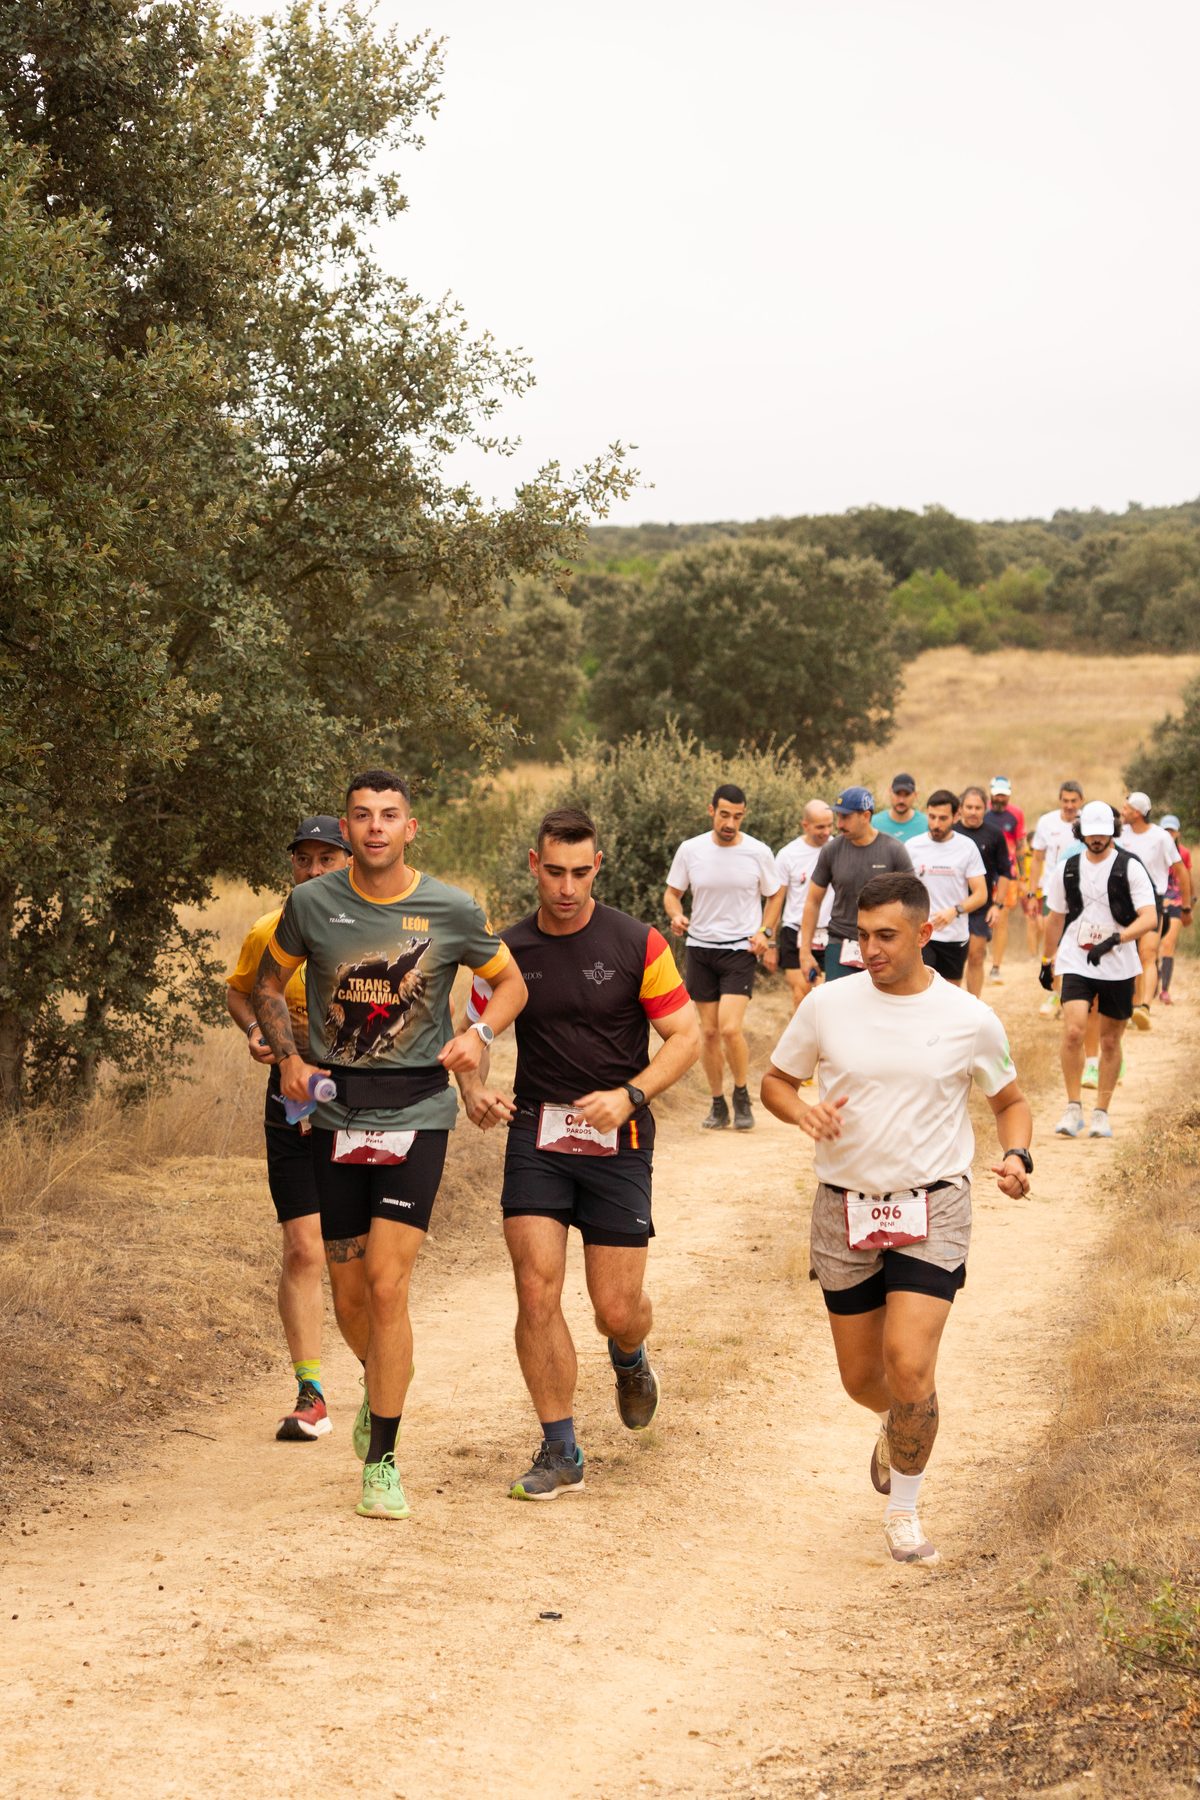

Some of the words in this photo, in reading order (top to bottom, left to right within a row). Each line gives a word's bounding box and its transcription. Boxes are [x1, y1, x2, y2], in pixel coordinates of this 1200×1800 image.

[402, 915, 429, 932] LEÓN
[347, 978, 391, 993] TRANS
[337, 989, 400, 1005] CANDAMIA
[566, 1127, 592, 1135] PARDOS
[871, 1205, 902, 1220] 096
